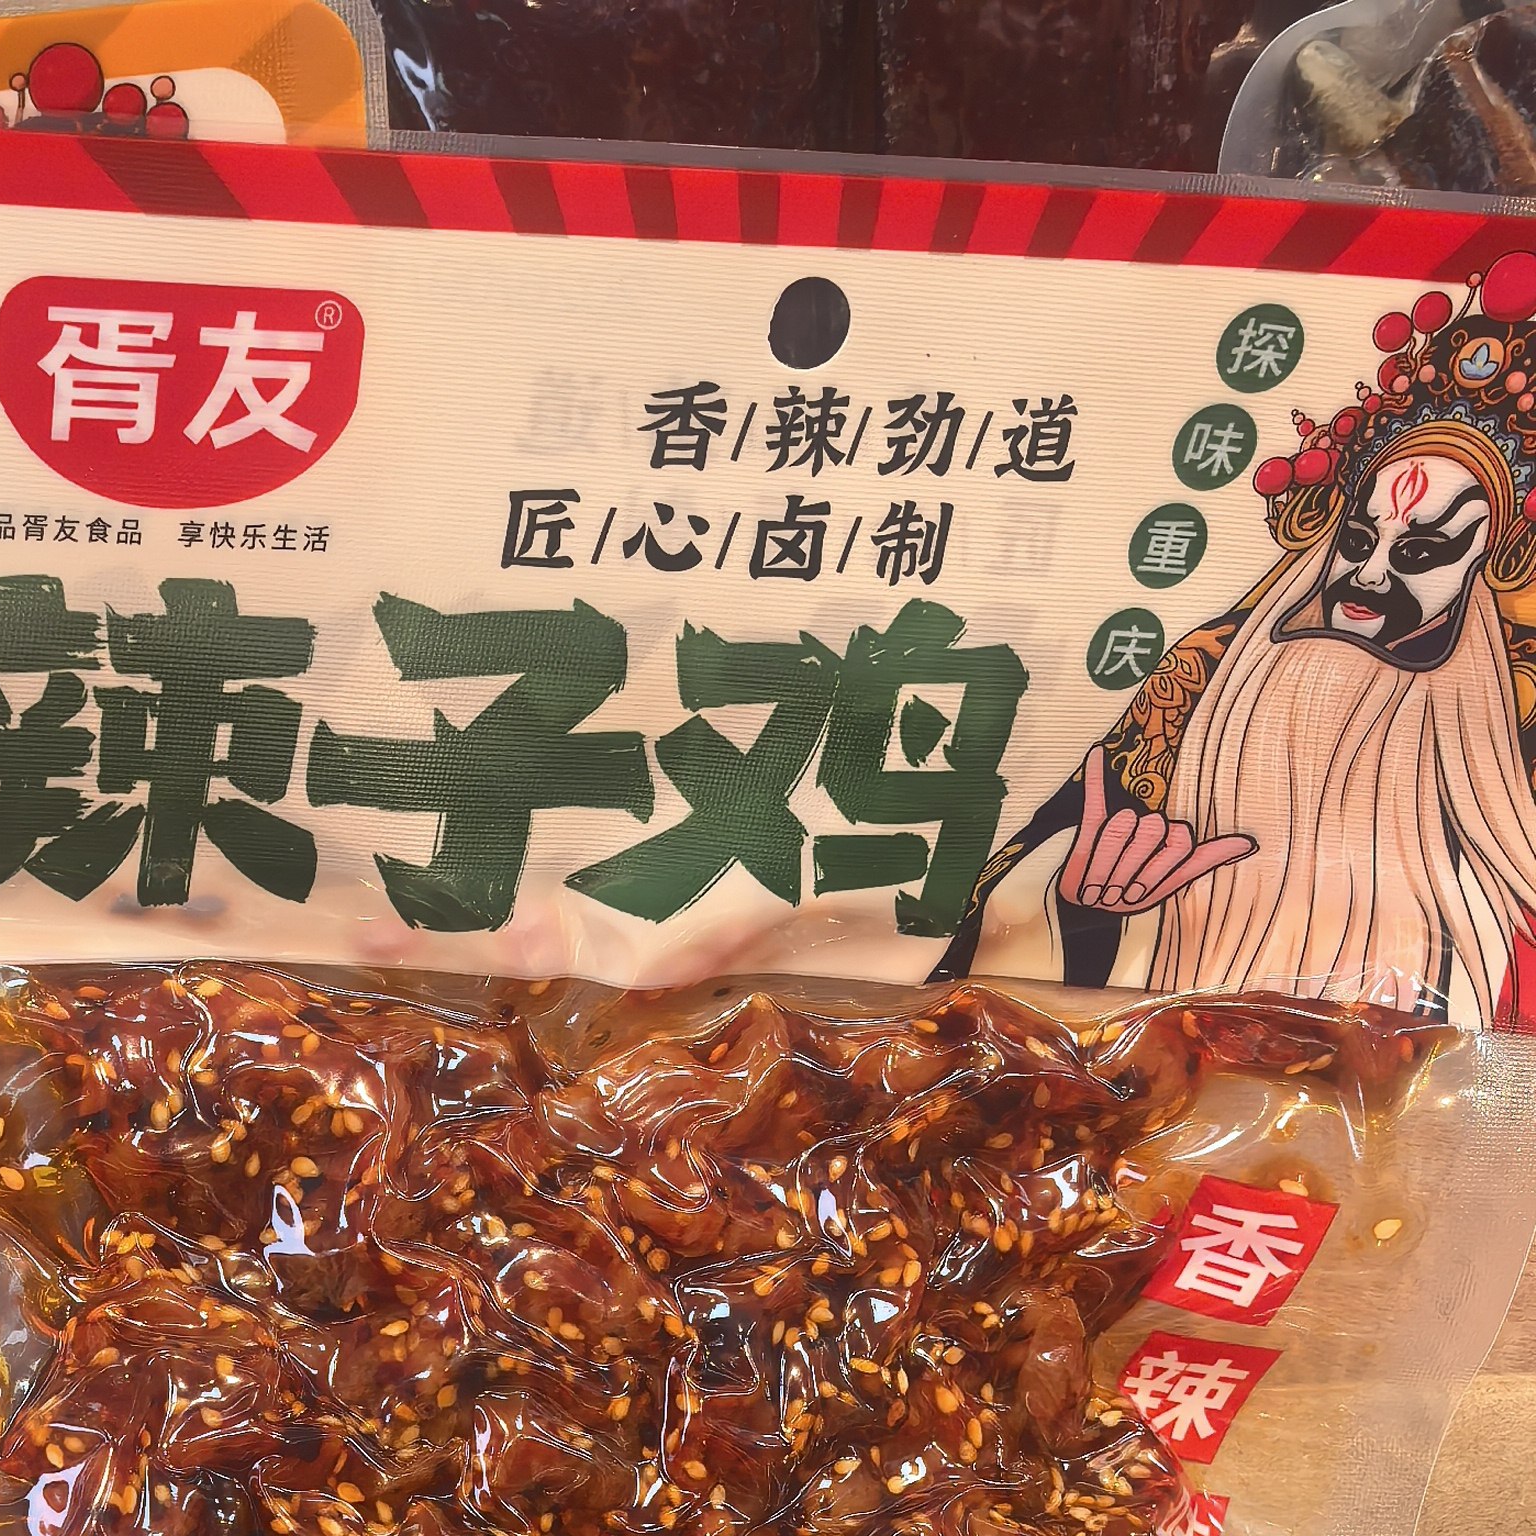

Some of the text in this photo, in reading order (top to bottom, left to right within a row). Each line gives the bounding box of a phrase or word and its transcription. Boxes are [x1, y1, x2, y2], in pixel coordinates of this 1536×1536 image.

[37, 307, 325, 454] 胥友
[176, 519, 331, 554] 享快乐生活
[1094, 316, 1297, 678] 探味重庆
